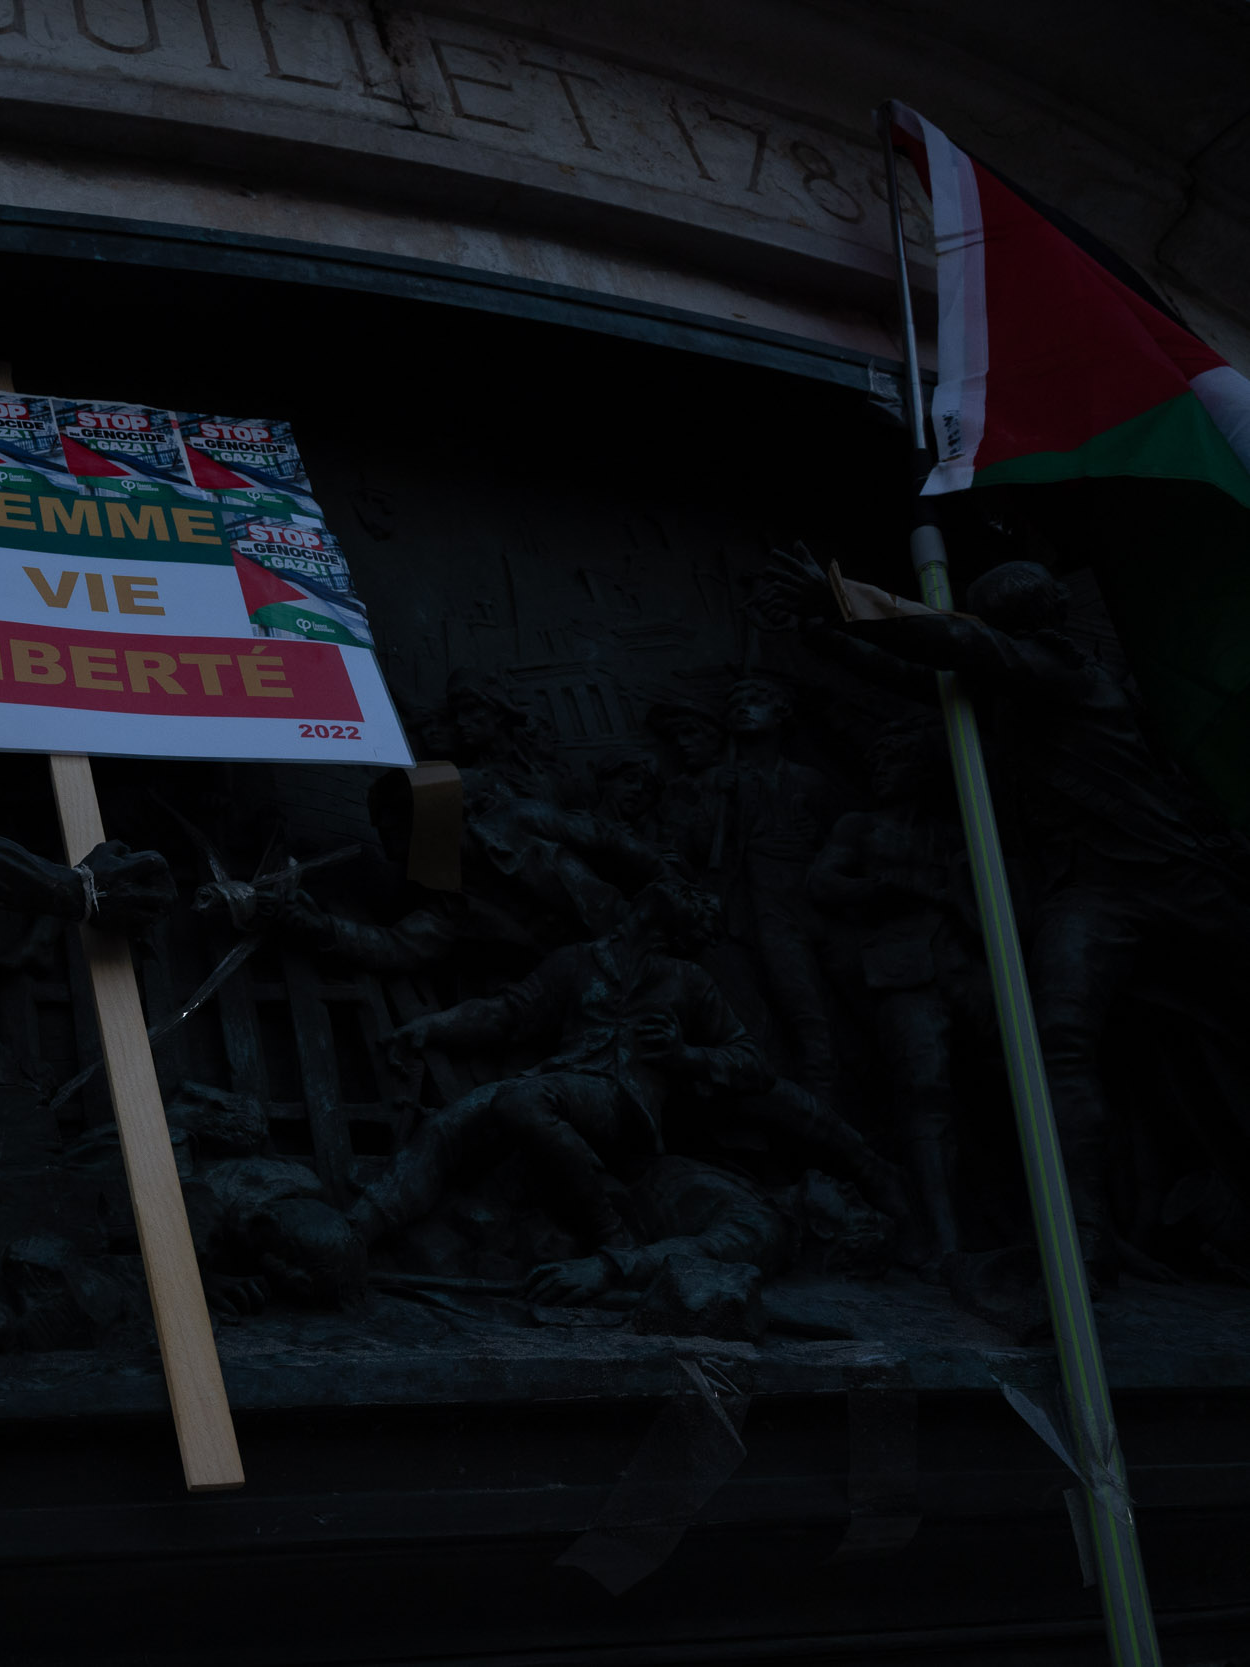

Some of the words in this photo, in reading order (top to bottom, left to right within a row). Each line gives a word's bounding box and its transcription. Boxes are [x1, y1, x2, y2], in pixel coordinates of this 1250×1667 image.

[77, 411, 149, 431] STOP
[200, 423, 269, 442] STOP
[248, 524, 320, 548] STOP
[22, 566, 165, 616] VIE
[298, 724, 362, 740] 2022
